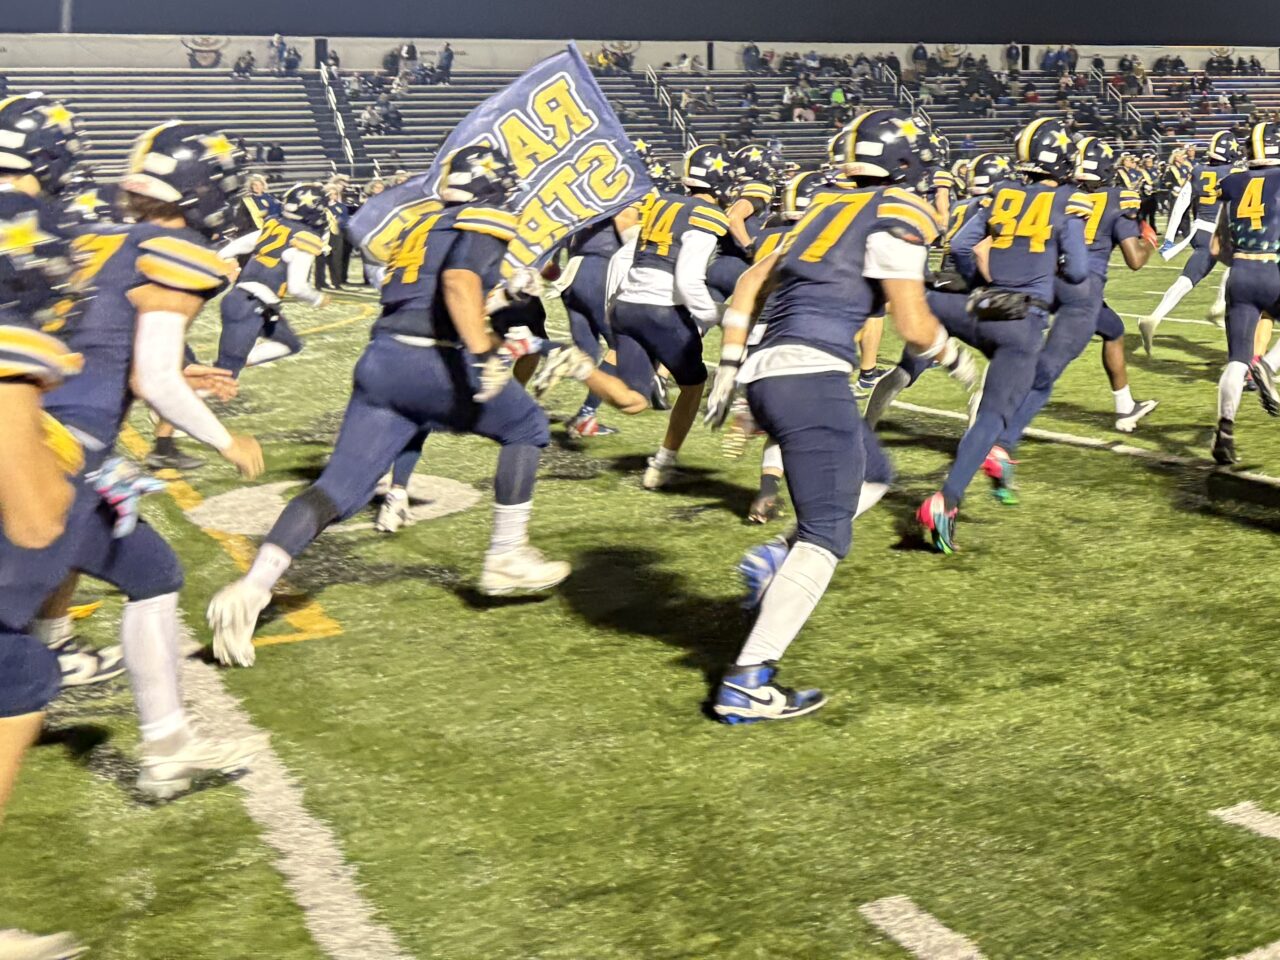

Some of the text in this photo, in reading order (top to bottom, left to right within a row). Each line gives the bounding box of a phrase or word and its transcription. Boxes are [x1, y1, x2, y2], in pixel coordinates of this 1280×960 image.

[780, 191, 877, 262] 77
[988, 188, 1056, 253] 84
[1236, 177, 1266, 230] 4
